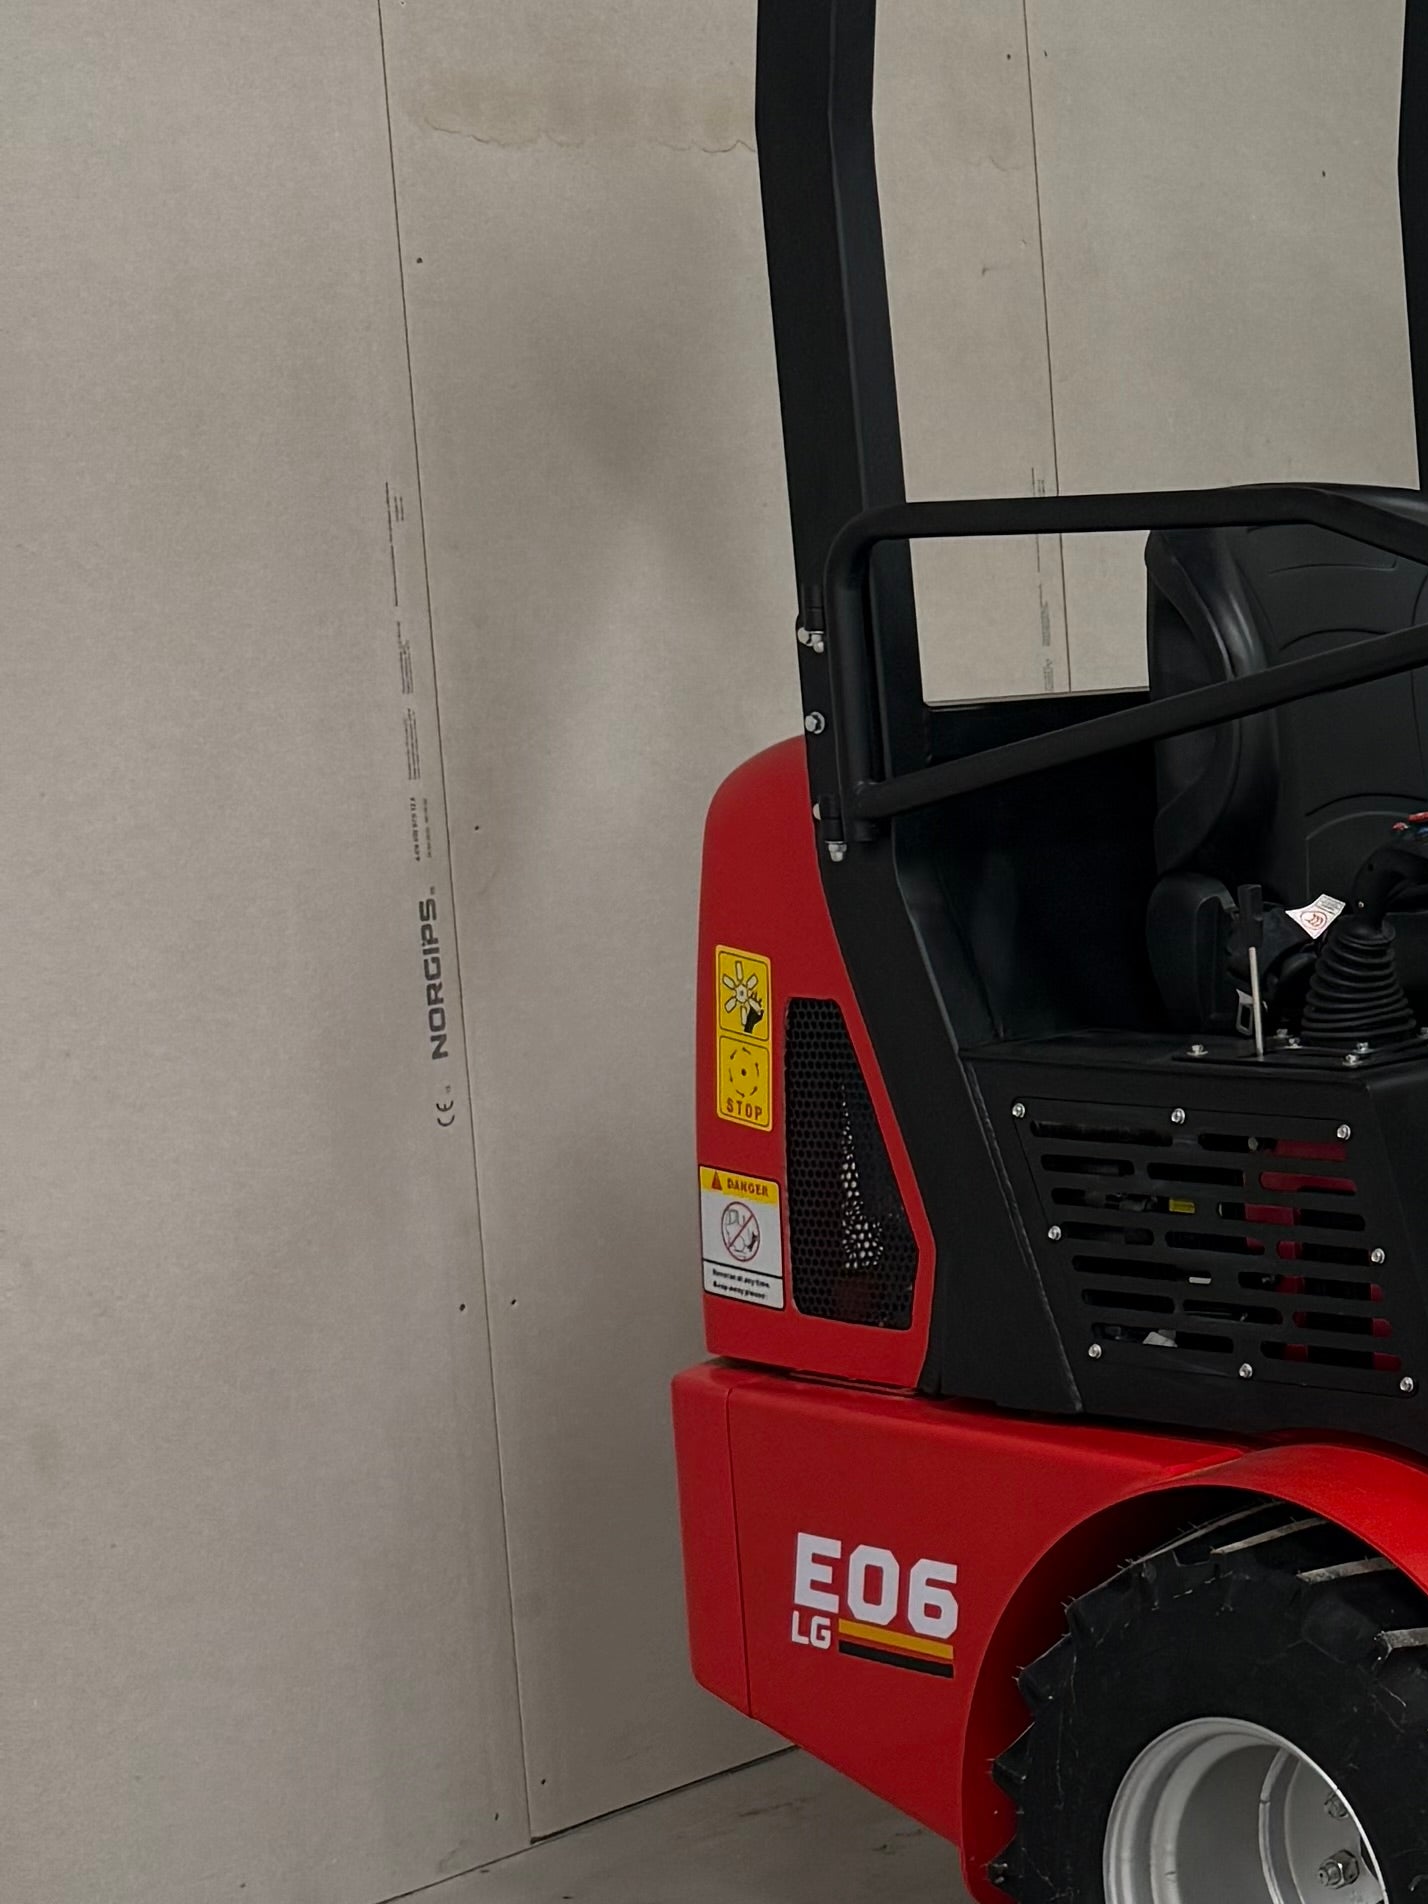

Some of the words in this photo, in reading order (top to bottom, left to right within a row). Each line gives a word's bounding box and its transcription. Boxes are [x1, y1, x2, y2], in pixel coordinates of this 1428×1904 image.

[419, 898, 449, 1060] NORGIPS
[726, 1097, 762, 1120] STOP
[727, 1178, 769, 1197] DANGER
[794, 1532, 959, 1640] E06
[791, 1610, 831, 1650] LG
